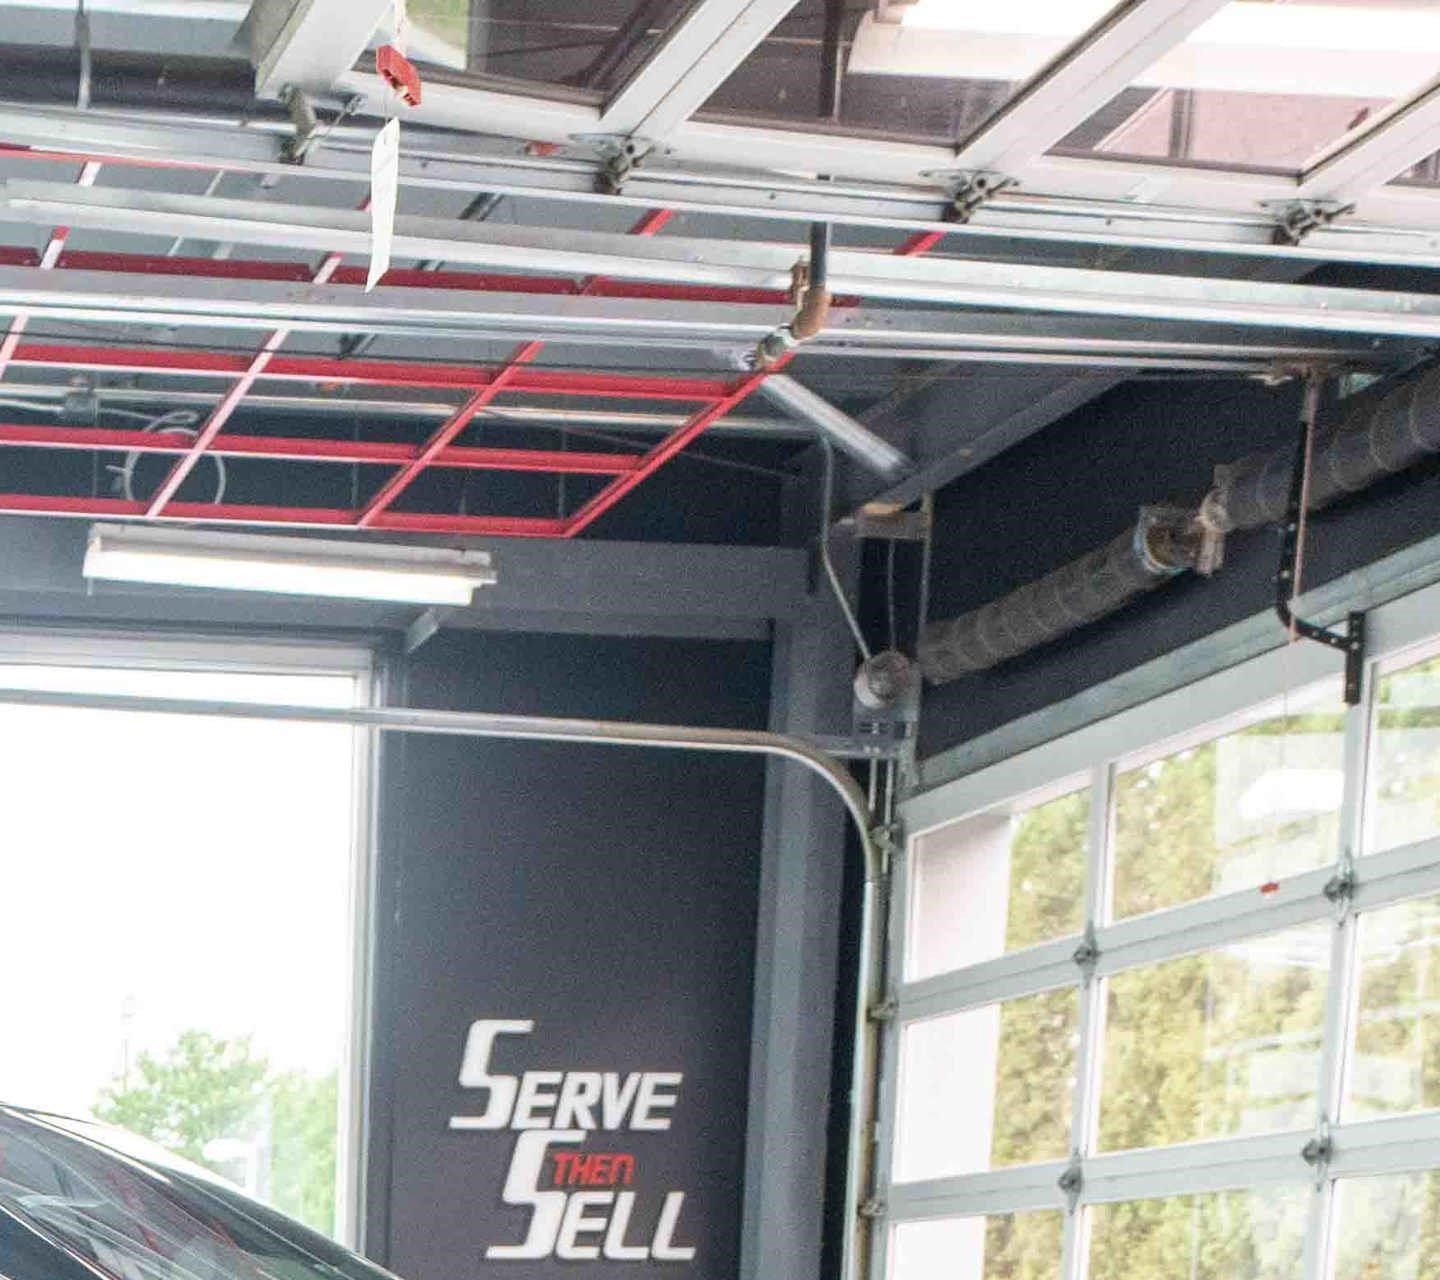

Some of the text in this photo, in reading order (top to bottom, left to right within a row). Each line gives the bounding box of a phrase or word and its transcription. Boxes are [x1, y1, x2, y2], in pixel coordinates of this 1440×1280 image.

[449, 1018, 684, 1131] SERVE
[486, 1129, 697, 1260] SELL
[551, 1152, 635, 1185] THEN
